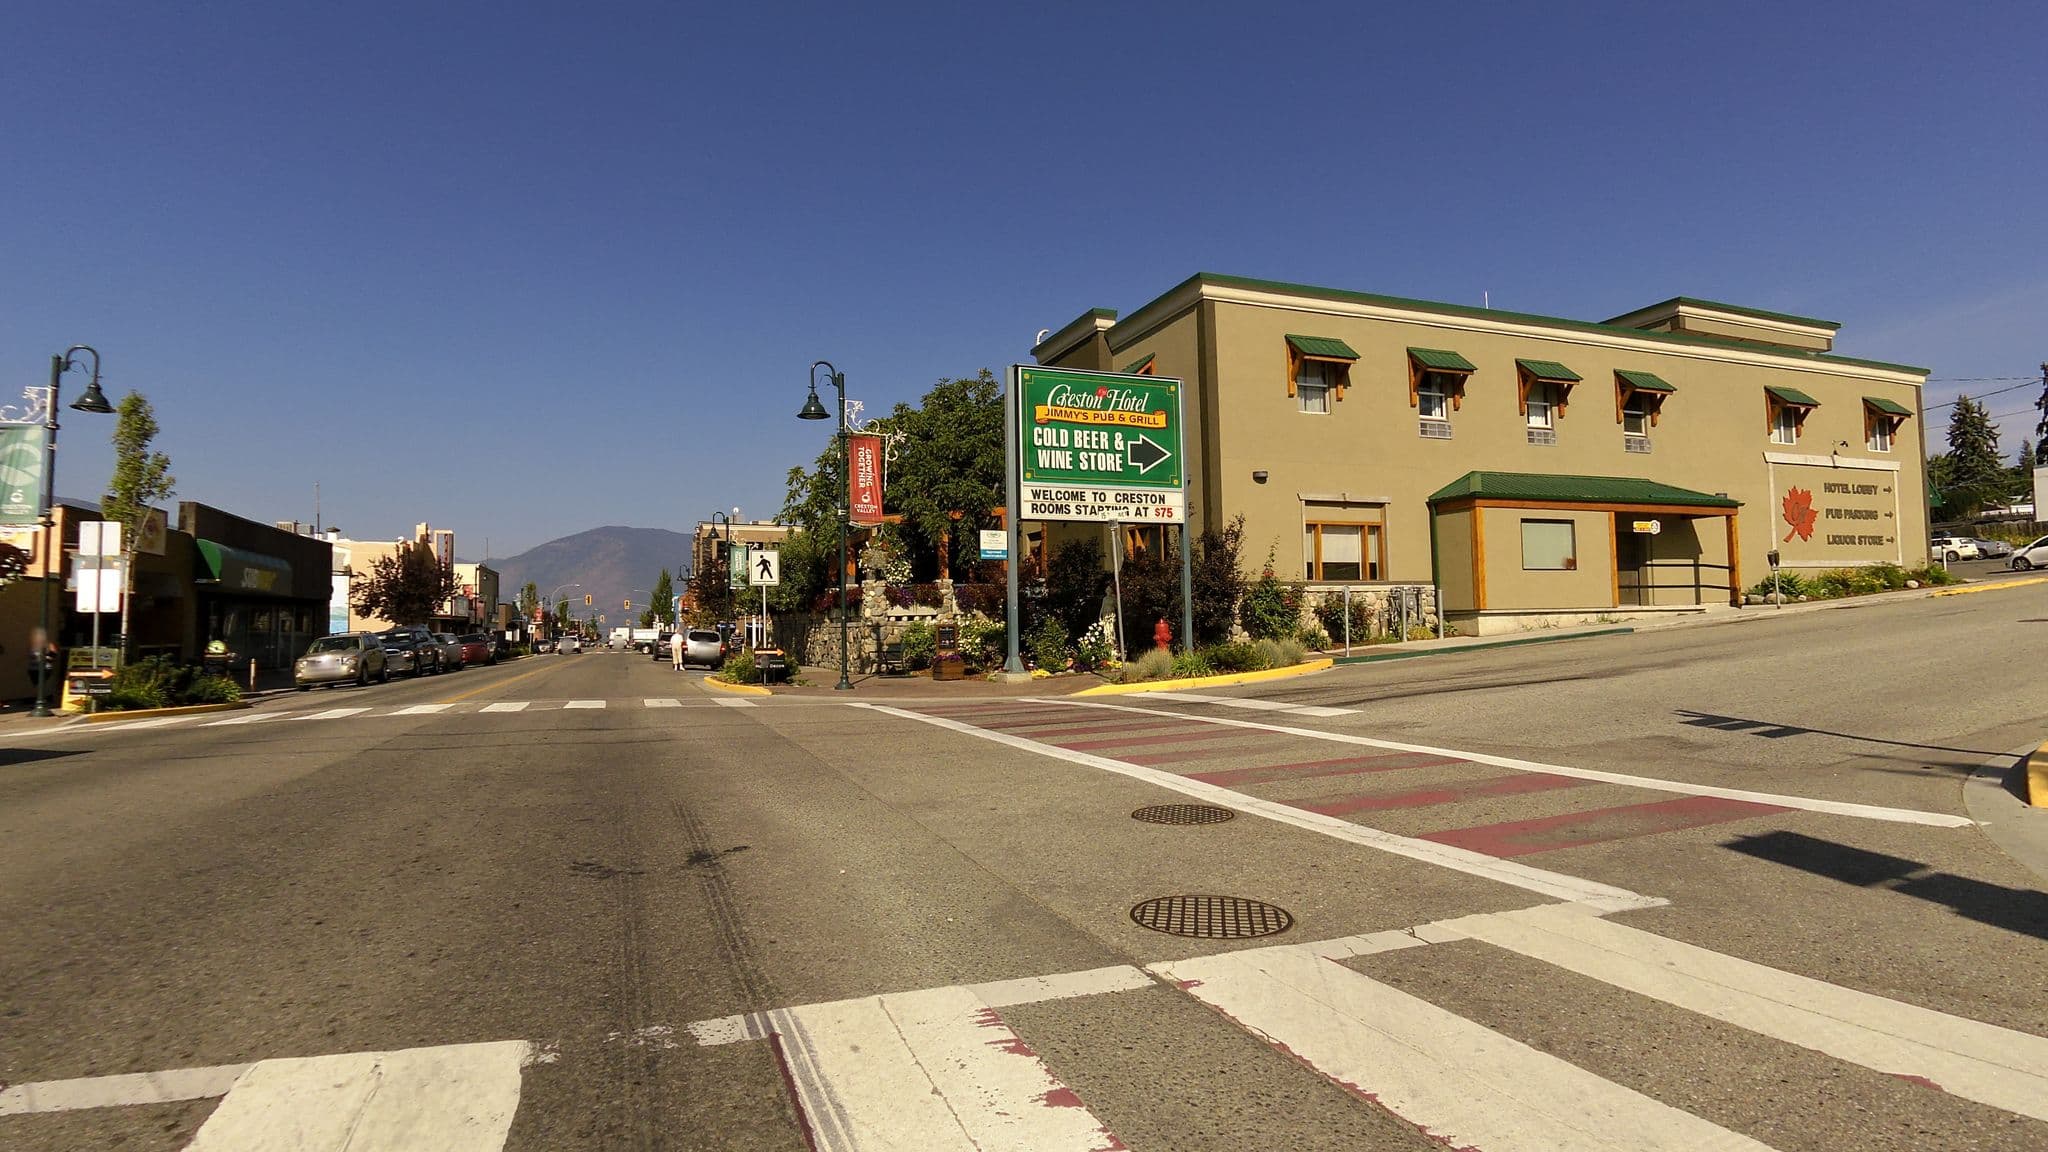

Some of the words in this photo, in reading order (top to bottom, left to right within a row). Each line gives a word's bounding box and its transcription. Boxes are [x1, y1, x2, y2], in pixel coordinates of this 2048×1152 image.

[1047, 384, 1102, 412] Creston
[1106, 389, 1149, 412] Hotel
[1045, 408, 1089, 421] JIMMY'S
[1093, 414, 1115, 422] PUB
[1118, 414, 1126, 422] &
[1129, 415, 1159, 425] GRILL
[1033, 427, 1069, 447] COLD
[1073, 430, 1109, 450] BEER
[1114, 432, 1125, 450] &
[858, 446, 866, 488] TOGETHER
[865, 448, 873, 487] GROWING
[1037, 449, 1073, 469] WINE
[1080, 452, 1123, 472] STORE
[1031, 489, 1086, 502] WELCOME
[1092, 492, 1106, 503] TO
[1115, 493, 1166, 504] CRESTON
[1823, 482, 1852, 494] HOTEL
[1852, 484, 1879, 495] LOBBY
[1031, 503, 1071, 515] ROOMS
[1134, 507, 1149, 517] AT
[1154, 508, 1173, 518] $75
[1825, 508, 1842, 519] PUB
[1844, 509, 1878, 520] PARKING
[1827, 534, 1857, 545] LIQUOR
[1858, 535, 1884, 546] STORE
